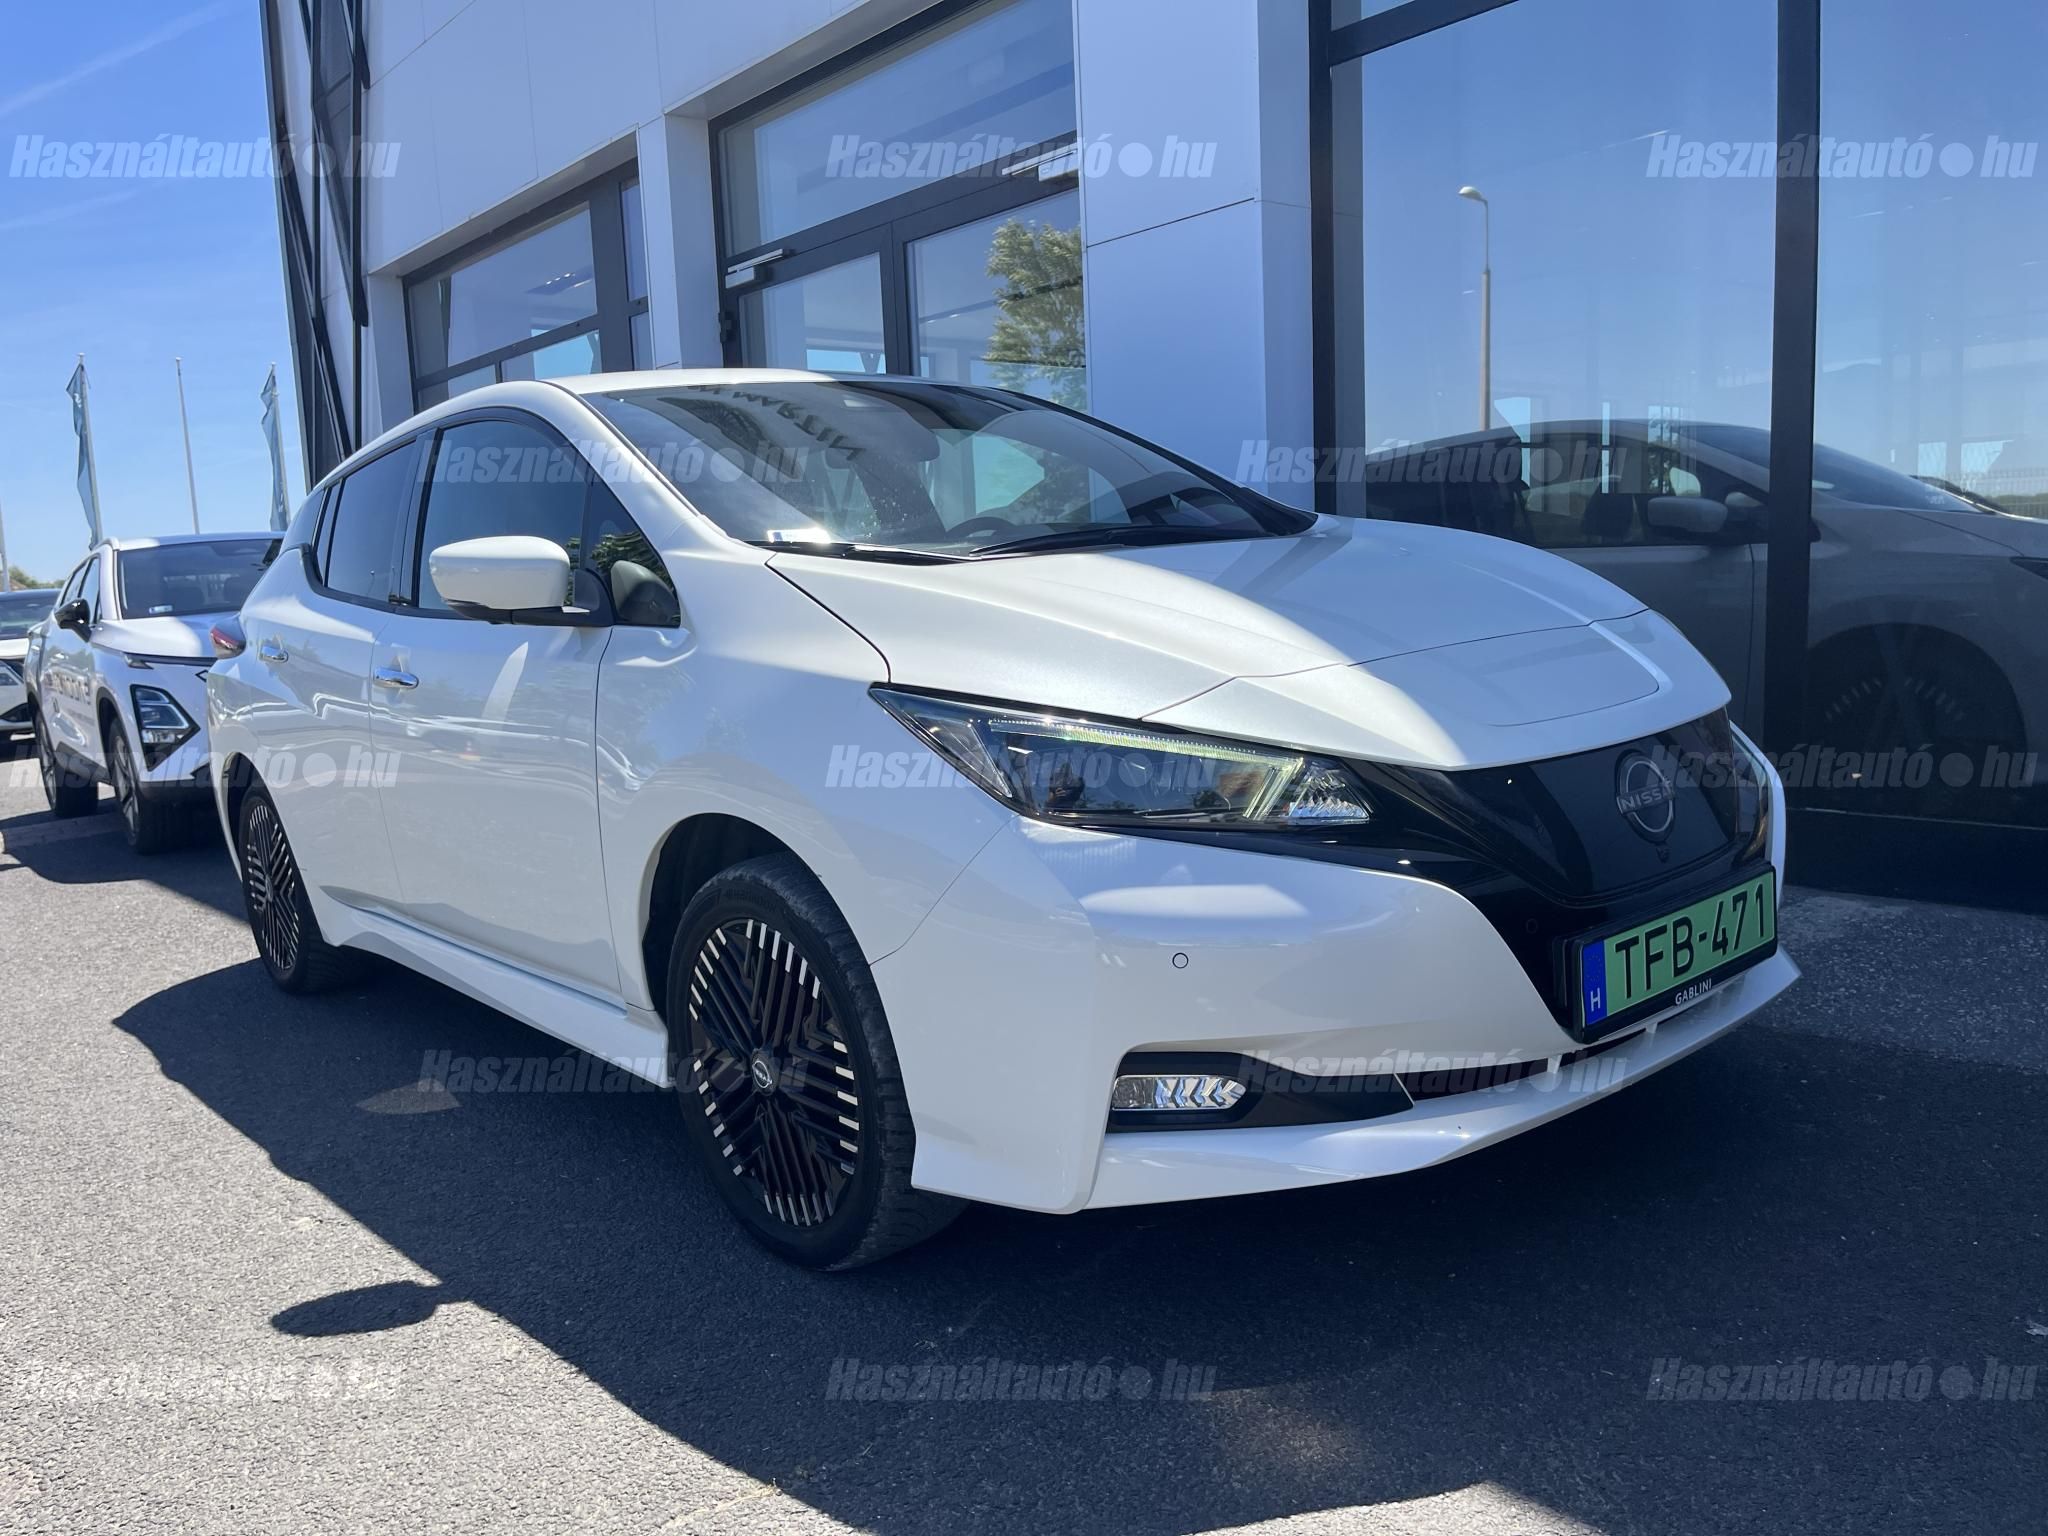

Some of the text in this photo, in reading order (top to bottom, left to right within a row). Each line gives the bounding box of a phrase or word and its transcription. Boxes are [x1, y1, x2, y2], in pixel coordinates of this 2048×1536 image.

[1615, 883, 1764, 999] TFB-471
[1590, 987, 1601, 1012] H
[1675, 978, 1712, 1006] GABLINI
